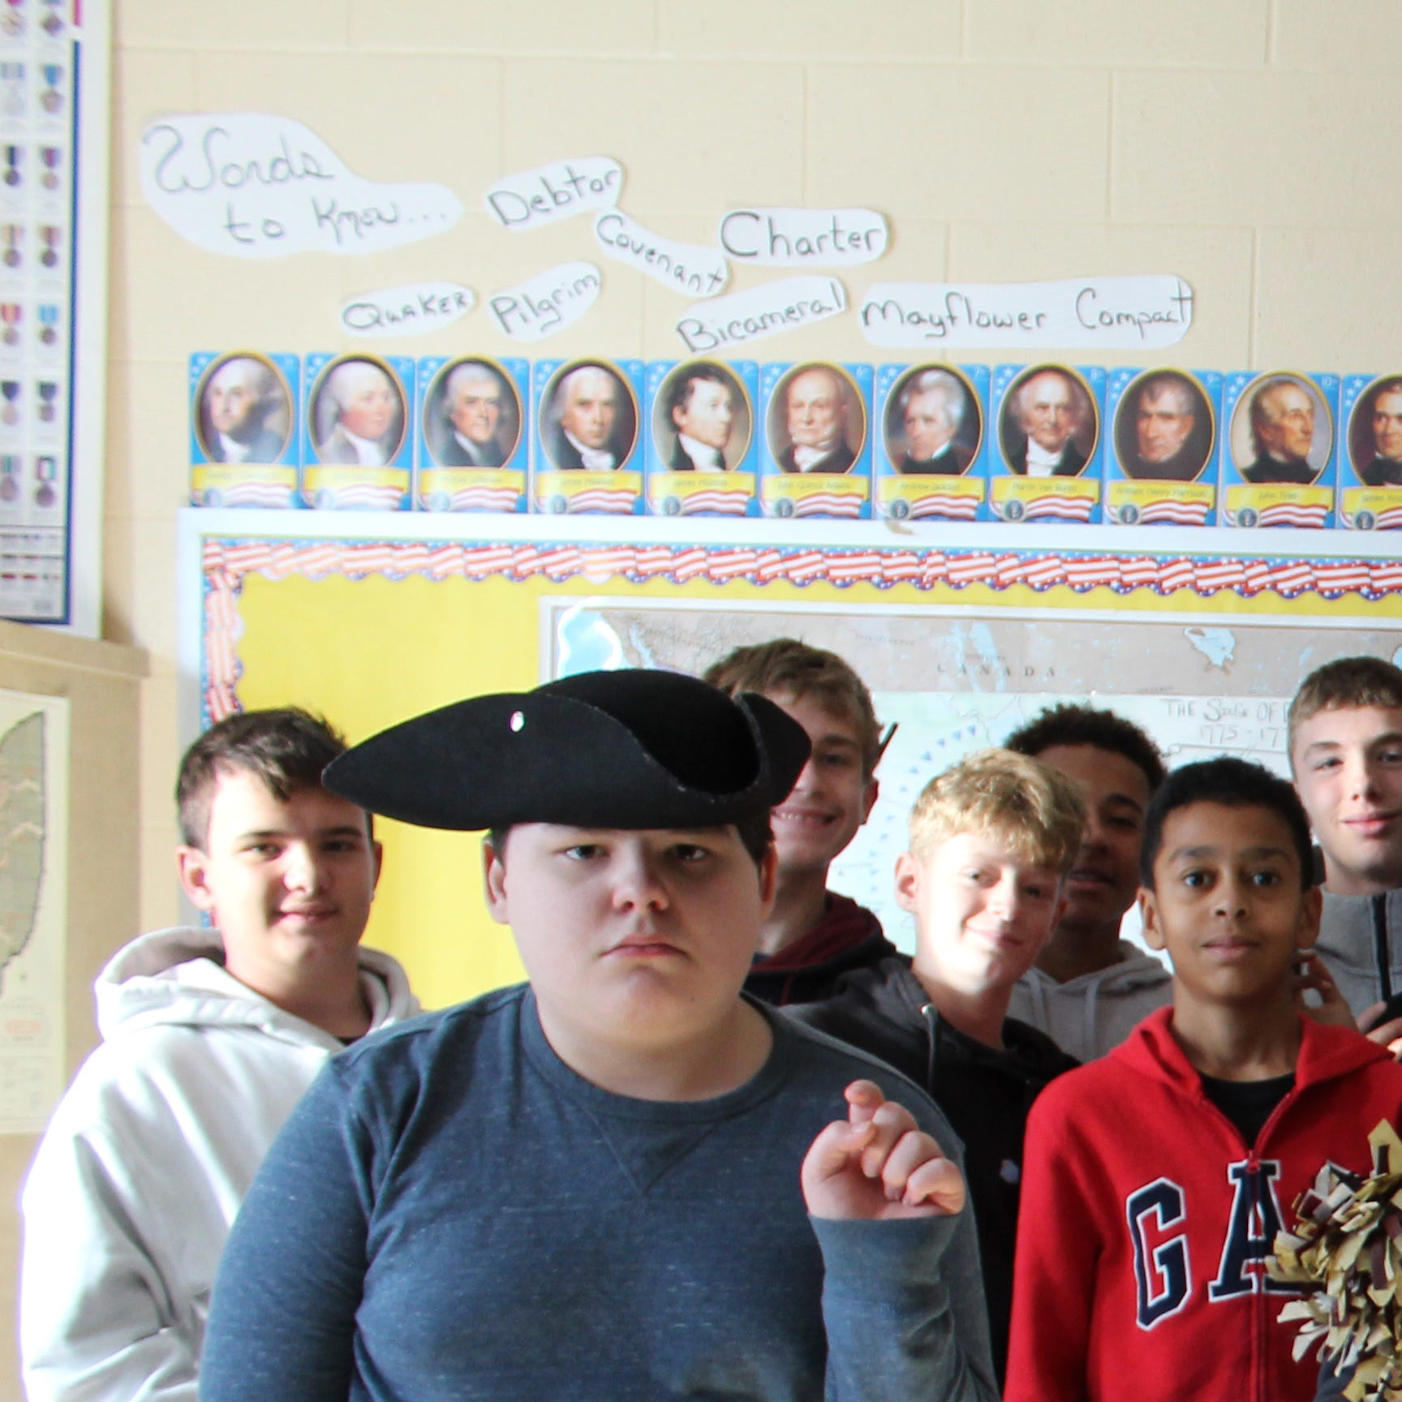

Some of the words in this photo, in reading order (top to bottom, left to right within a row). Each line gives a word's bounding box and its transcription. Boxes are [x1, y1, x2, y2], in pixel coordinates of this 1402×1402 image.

[143, 124, 335, 194] Words
[222, 202, 286, 245] to
[487, 165, 621, 227] Debtor
[595, 213, 728, 293] Covenant
[720, 211, 882, 259] Charter
[490, 268, 601, 338] Pilgrim
[676, 279, 846, 354] Bicameral
[862, 294, 1047, 337] Mayflower
[1074, 287, 1193, 329] Compact
